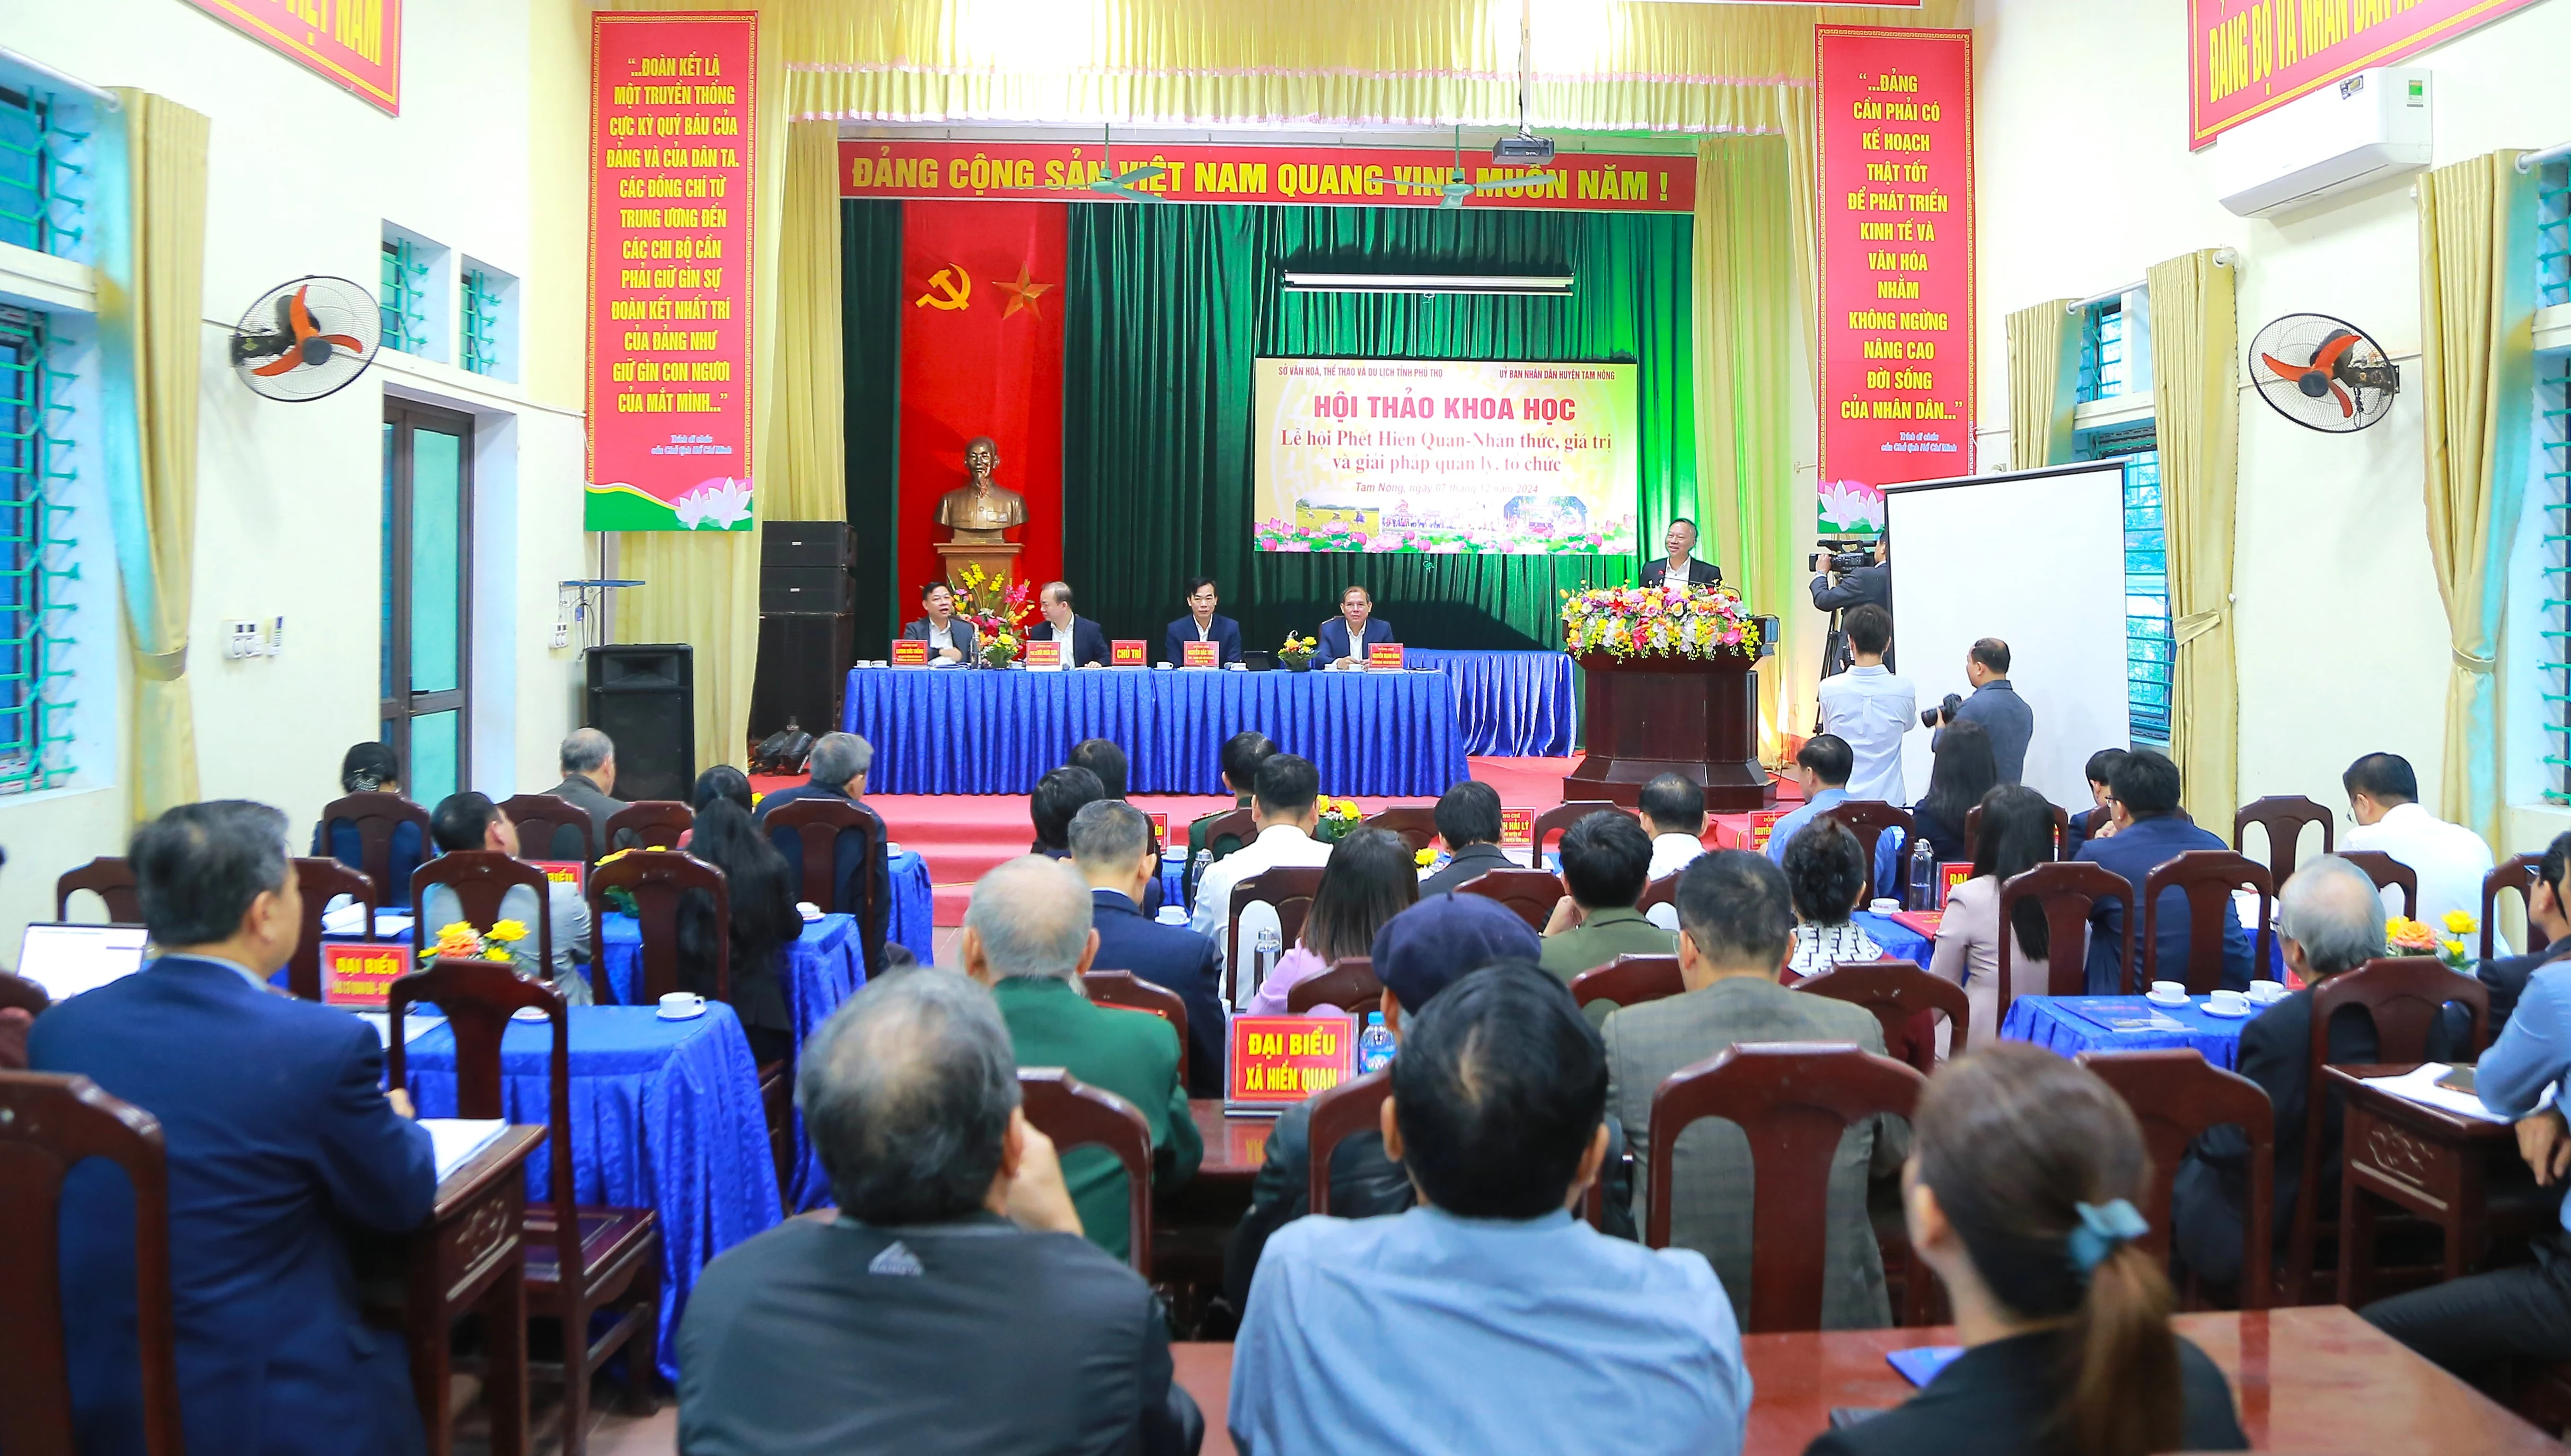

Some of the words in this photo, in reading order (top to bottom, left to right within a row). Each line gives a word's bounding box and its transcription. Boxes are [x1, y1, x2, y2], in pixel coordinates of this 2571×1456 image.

[679, 50, 701, 76] KẾT
[705, 53, 720, 76] LÀ
[614, 82, 641, 109] MỘT
[644, 79, 691, 105] TRUYỀN
[694, 80, 735, 105] THỐNG
[1853, 96, 1882, 120] CẦN
[1886, 97, 1917, 122] PHẢI
[1922, 100, 1941, 122] CÓ
[609, 114, 635, 140] CỰC
[638, 113, 654, 136] KỲ
[657, 112, 681, 138] QUÝ
[684, 112, 709, 136] BÁU
[712, 108, 738, 136] CỦA
[1862, 127, 1881, 151] KẾ
[1884, 133, 1930, 155] HOẠCH
[606, 141, 641, 169] ĐẢNG
[644, 145, 660, 168] VÀ
[663, 140, 688, 168] CỦA
[691, 145, 718, 167] DÂN
[720, 148, 739, 167] TA.
[619, 175, 645, 198] CÁC
[647, 172, 682, 198] ĐỒNG
[685, 175, 706, 198] CHÍ
[709, 174, 727, 198] TỪ
[852, 146, 938, 189] ĐẢNG
[949, 153, 1037, 196] CỘNG
[1194, 162, 1267, 194] NAM
[1276, 163, 1384, 197] QUANG
[1578, 163, 1648, 201] NĂM
[1659, 171, 1668, 201] !
[1866, 160, 1900, 185] THẬT
[1903, 160, 1928, 183] TỐT
[1847, 186, 1867, 210] ĐỂ
[1869, 189, 1905, 211] PHÁT
[1908, 188, 1948, 213] TRIỂN
[620, 209, 661, 228] TRUNG
[664, 207, 699, 228] ƯƠNG
[701, 201, 727, 228] ĐẾN
[1861, 223, 1894, 241] KINH
[1897, 217, 1914, 241] TẾ
[1916, 220, 1935, 242] VÀ
[622, 236, 647, 260] CÁC
[650, 239, 672, 260] CHI
[675, 236, 692, 263] BỘ
[695, 233, 722, 260] CẦN
[1868, 249, 1898, 271] VĂN
[1901, 250, 1927, 271] HÓA
[621, 261, 650, 289] PHẢI
[654, 266, 678, 289] GIỮ
[678, 265, 700, 289] GÌN
[703, 267, 723, 293] SỰ
[1877, 274, 1919, 299] NHẰM
[611, 296, 646, 321] ĐOÀN
[649, 294, 672, 321] KẾT
[675, 294, 707, 321] NHẤT
[710, 296, 731, 320] TRÍ
[1848, 308, 1896, 330] KHÔNG
[1900, 310, 1948, 331] NGỪNG
[624, 323, 650, 352] CỦA
[652, 323, 686, 351] ĐẢNG
[690, 329, 718, 351] NHƯ
[1864, 337, 1903, 360] NÂNG
[1906, 341, 1934, 360] CAO
[612, 359, 635, 383] GIỮ
[636, 358, 659, 383] GÌN
[662, 362, 688, 383] CON
[1278, 364, 1288, 376] SỞ
[1289, 365, 1304, 376] VĂN
[1323, 363, 1336, 376] THỂ
[1338, 367, 1355, 376] THAO
[1357, 365, 1366, 376] VÀ
[1368, 367, 1377, 376] DU
[1379, 367, 1395, 378] LỊCH
[1397, 365, 1412, 377] TỈNH
[1414, 366, 1428, 377] PHÚ
[1430, 368, 1443, 380] THỌ
[1510, 369, 1523, 379] BAN
[1524, 368, 1543, 379] NHÂN
[1544, 368, 1557, 380] DÂN
[1559, 368, 1580, 381] HUYỆN
[1582, 370, 1595, 380] TAM
[1597, 369, 1615, 380] NÔNG
[1867, 367, 1890, 390] ĐỜI
[1894, 365, 1933, 390] SỐNG
[618, 385, 643, 413] CỦA
[646, 387, 673, 412] MẮT
[1314, 391, 1357, 422] HỘI
[1367, 387, 1434, 418] THẢO
[1445, 398, 1515, 419] KHOA
[1524, 399, 1575, 426] HỌC
[1841, 393, 1869, 420] CỦA
[1873, 399, 1912, 420] NHÂN
[1281, 427, 1301, 446] Lễ
[1307, 430, 1331, 449] hội
[1337, 429, 1372, 446] Phết
[1521, 433, 1559, 451] thức,
[1564, 433, 1588, 452] giá
[1593, 434, 1612, 453] trị
[1333, 453, 1350, 469] và
[1356, 453, 1384, 473] giải
[1390, 455, 1430, 474] pháp
[1525, 456, 1561, 471] chức
[1356, 482, 1375, 492] Tam
[1517, 484, 1538, 493] 2024
[1116, 645, 1130, 659] CHỦ
[1131, 647, 1142, 659] TRÌ
[1509, 818, 1520, 831] HẢI
[1521, 819, 1529, 831] LÝ
[1247, 1033, 1283, 1060] ĐẠI
[1289, 1025, 1336, 1056] BIỂU
[1245, 1062, 1264, 1091] XÃ
[1301, 1067, 1337, 1094] QUAN
